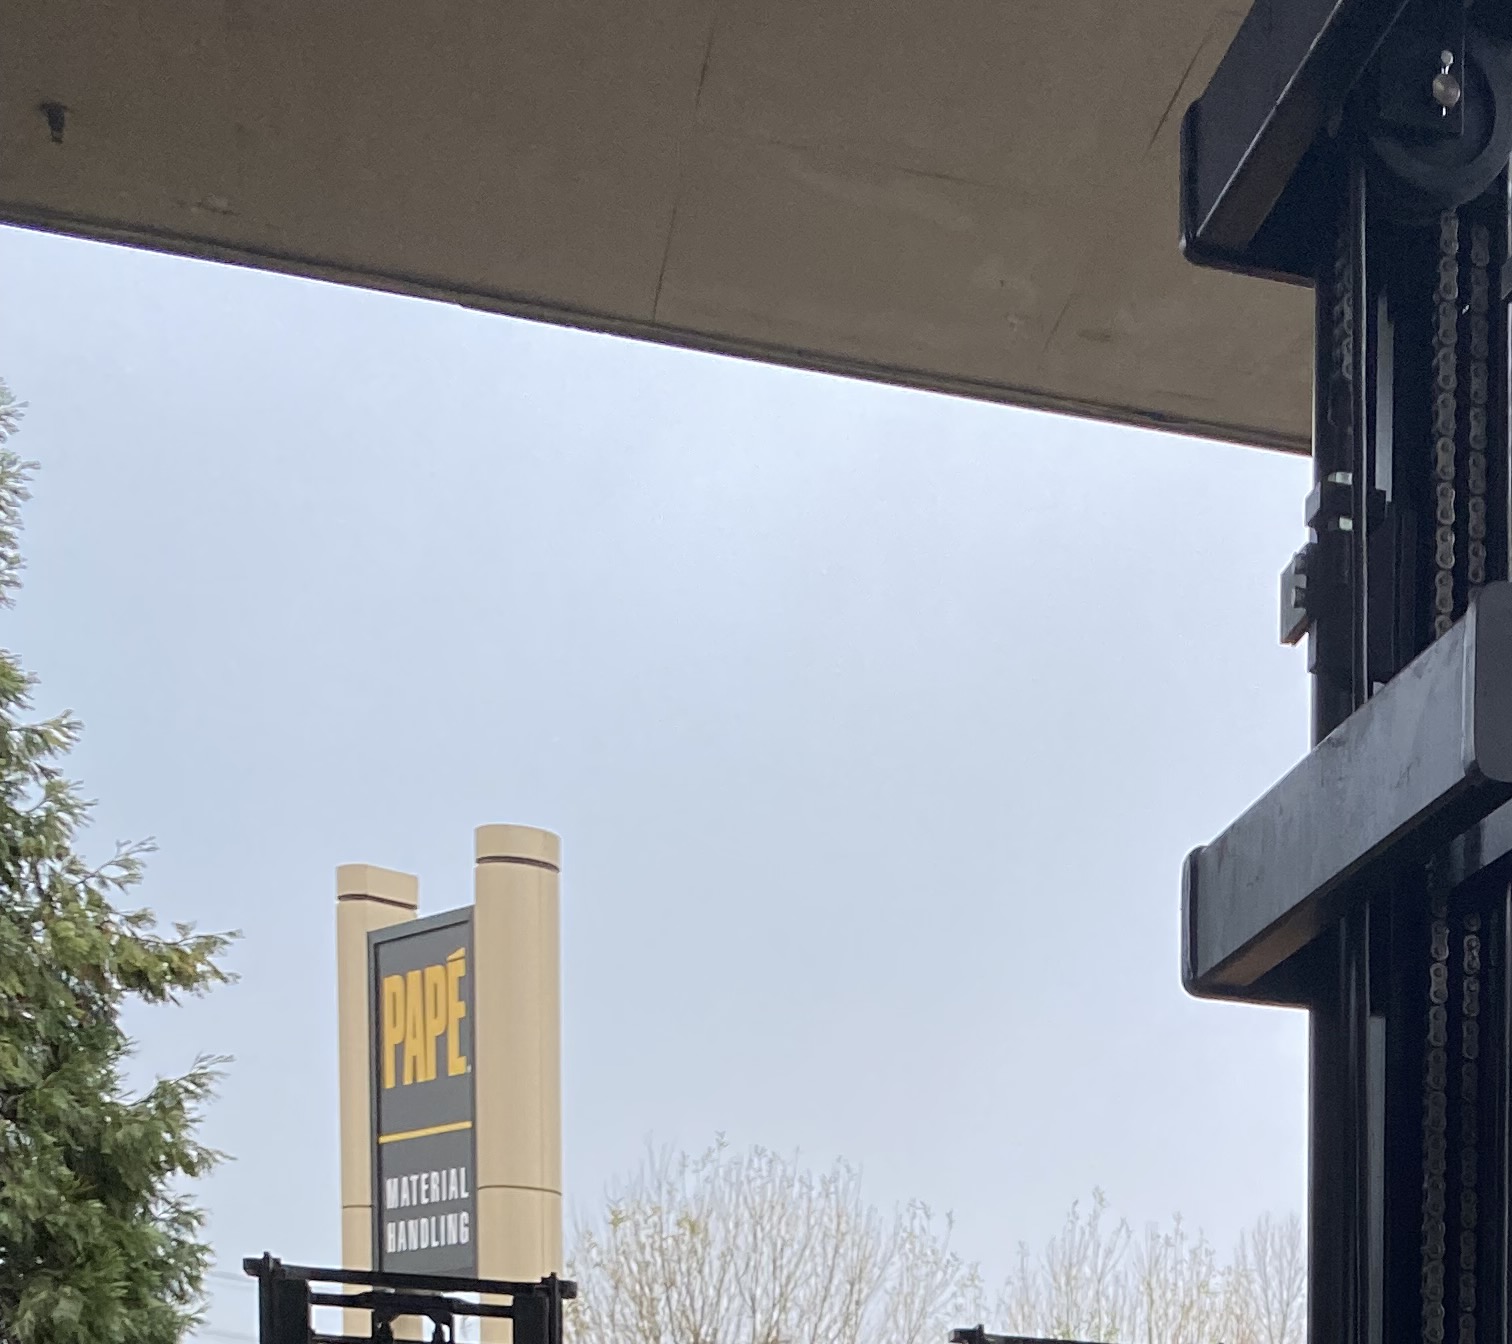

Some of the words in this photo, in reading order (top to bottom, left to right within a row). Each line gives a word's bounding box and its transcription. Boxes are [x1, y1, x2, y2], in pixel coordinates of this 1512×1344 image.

[383, 947, 467, 1089] PAPÉ
[385, 1166, 470, 1210] MATERIAL
[386, 1211, 470, 1254] HANDLING
